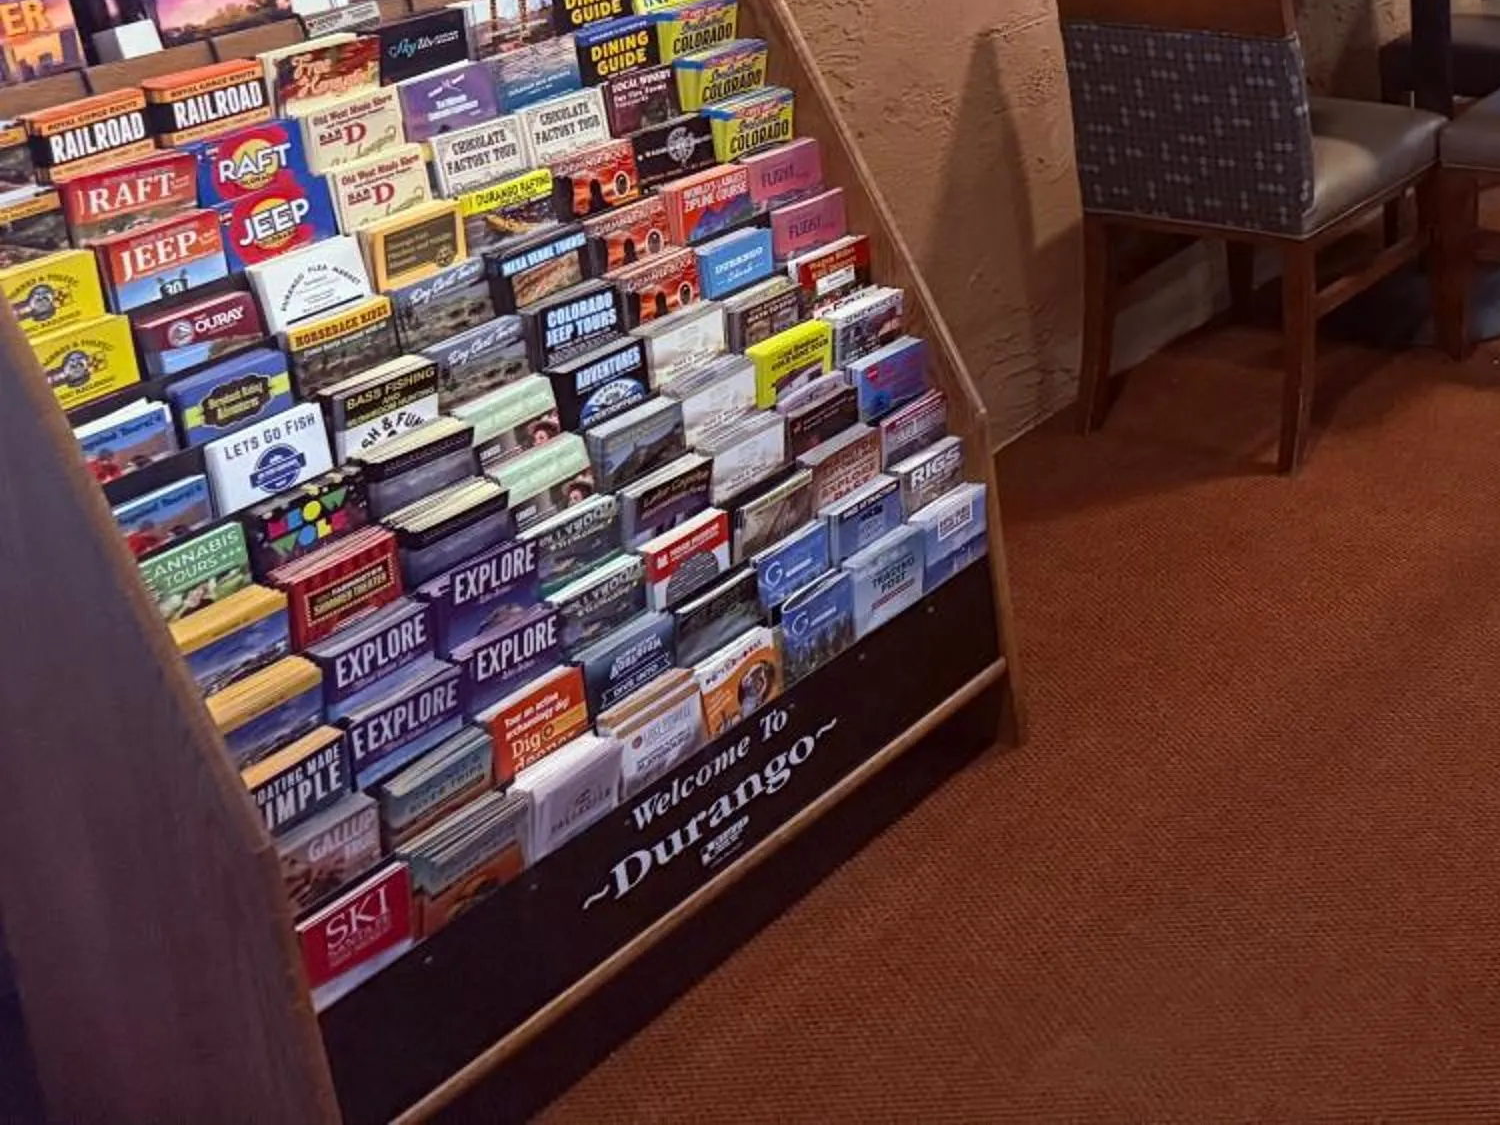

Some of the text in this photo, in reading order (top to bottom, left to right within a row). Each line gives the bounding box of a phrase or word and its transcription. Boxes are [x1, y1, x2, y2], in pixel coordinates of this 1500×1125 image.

[571, 0, 622, 25] GUIDE
[591, 31, 649, 62] DINING
[673, 22, 733, 56] COLORADO
[597, 49, 647, 76] GUIDE
[173, 80, 262, 129] RAILROAD
[702, 70, 762, 104] COLORADO
[534, 114, 600, 146] FACTORY TOUR
[540, 101, 590, 126] CHOCOLATE
[50, 111, 146, 164] RAILROAD
[343, 123, 367, 145] D
[452, 128, 507, 157] CHOCOLATE
[730, 118, 789, 154] COLORADO
[219, 143, 291, 183] RAFT
[446, 143, 517, 176] FACTORY TOUR
[89, 170, 176, 214] RAFT
[372, 181, 395, 205] D
[477, 182, 519, 208] DURANGO
[240, 198, 309, 246] JEEP
[119, 229, 198, 283] JEEP
[195, 306, 245, 332] OURAY
[546, 324, 577, 348] JEEP
[578, 307, 618, 337] TOURS
[547, 291, 614, 329] COLORADO
[295, 314, 359, 348] HORSEBACK
[576, 346, 641, 390] ADVENTURES
[347, 367, 435, 411] BASS FISHING
[224, 413, 316, 461] LETS GO FISH
[911, 444, 961, 490] RIGS
[164, 555, 218, 587] TOURS
[455, 542, 537, 606] EXPLORE
[335, 612, 428, 689] EXPLORE
[477, 615, 558, 682] EXPLORE
[367, 678, 460, 758] EXPLORE
[511, 735, 541, 761] Dig
[256, 767, 303, 807] OATING
[305, 744, 341, 773] MADE
[631, 736, 750, 831] Welcome
[760, 708, 789, 743] To
[264, 760, 343, 832] IMPLE
[308, 809, 375, 863] GALLUP
[326, 883, 390, 950] SKI
